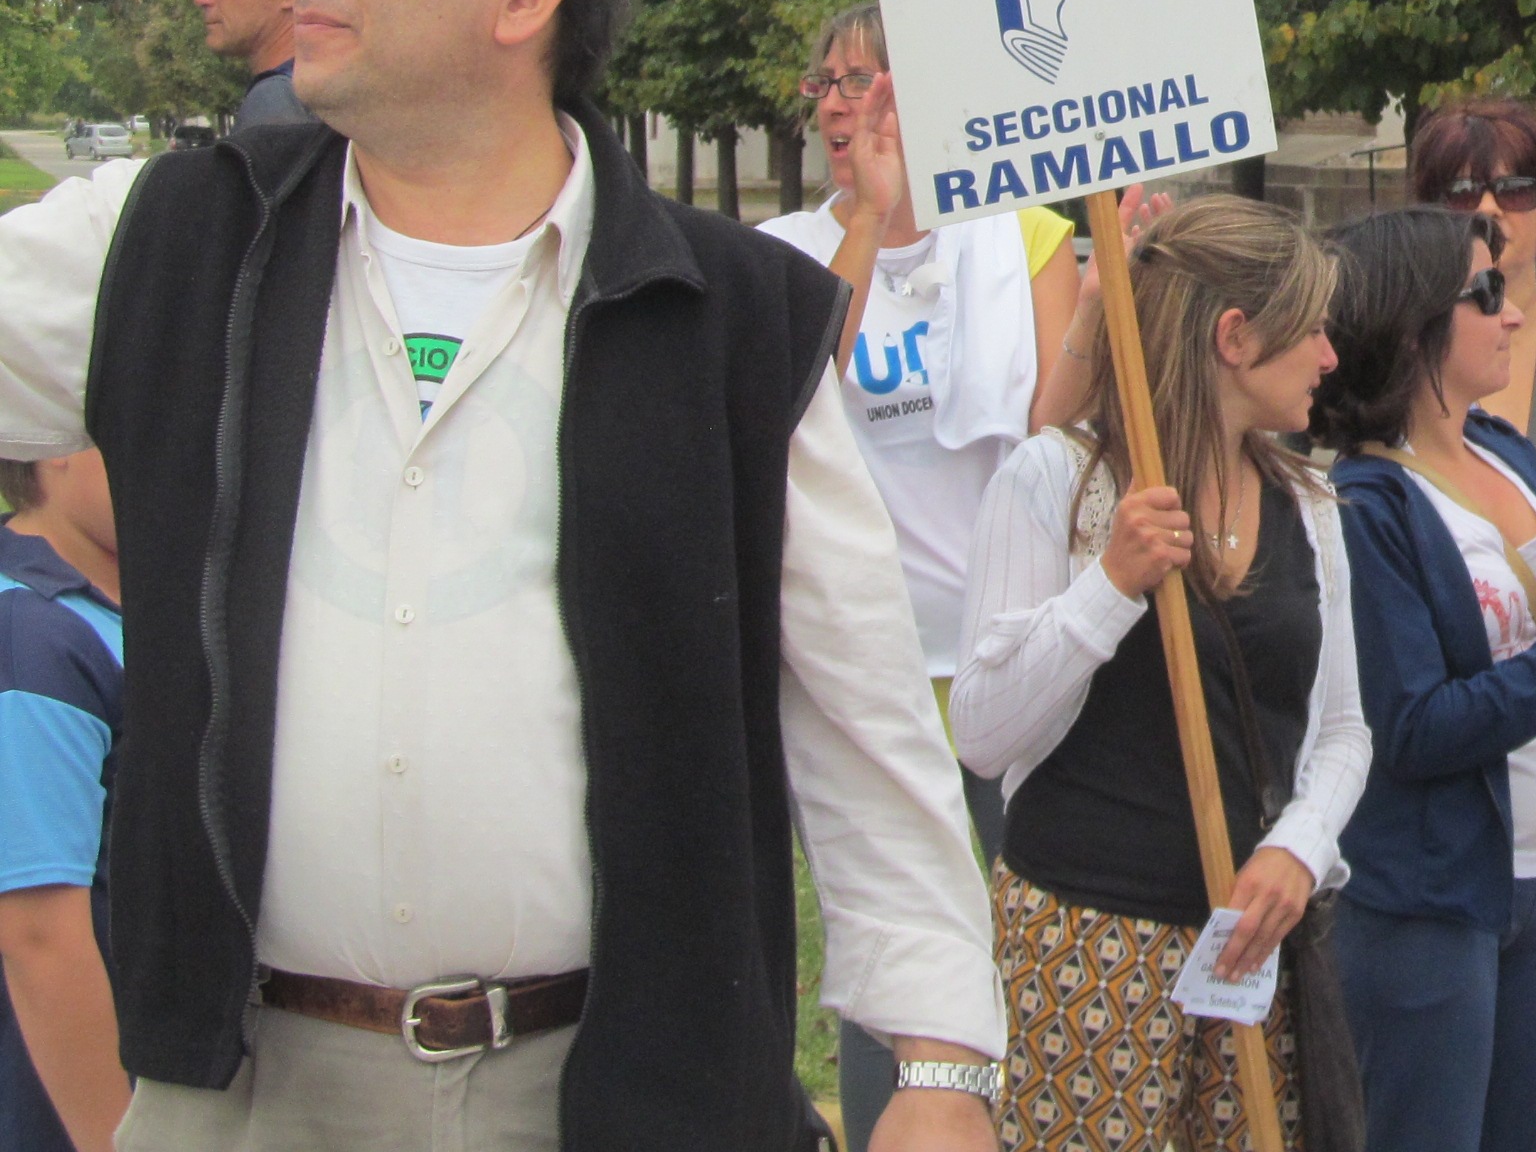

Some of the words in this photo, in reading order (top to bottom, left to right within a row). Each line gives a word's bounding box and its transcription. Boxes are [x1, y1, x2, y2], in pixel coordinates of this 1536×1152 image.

[964, 74, 1209, 152] SECCIONAL
[933, 110, 1251, 215] RAMALLO
[866, 403, 900, 423] UNION
